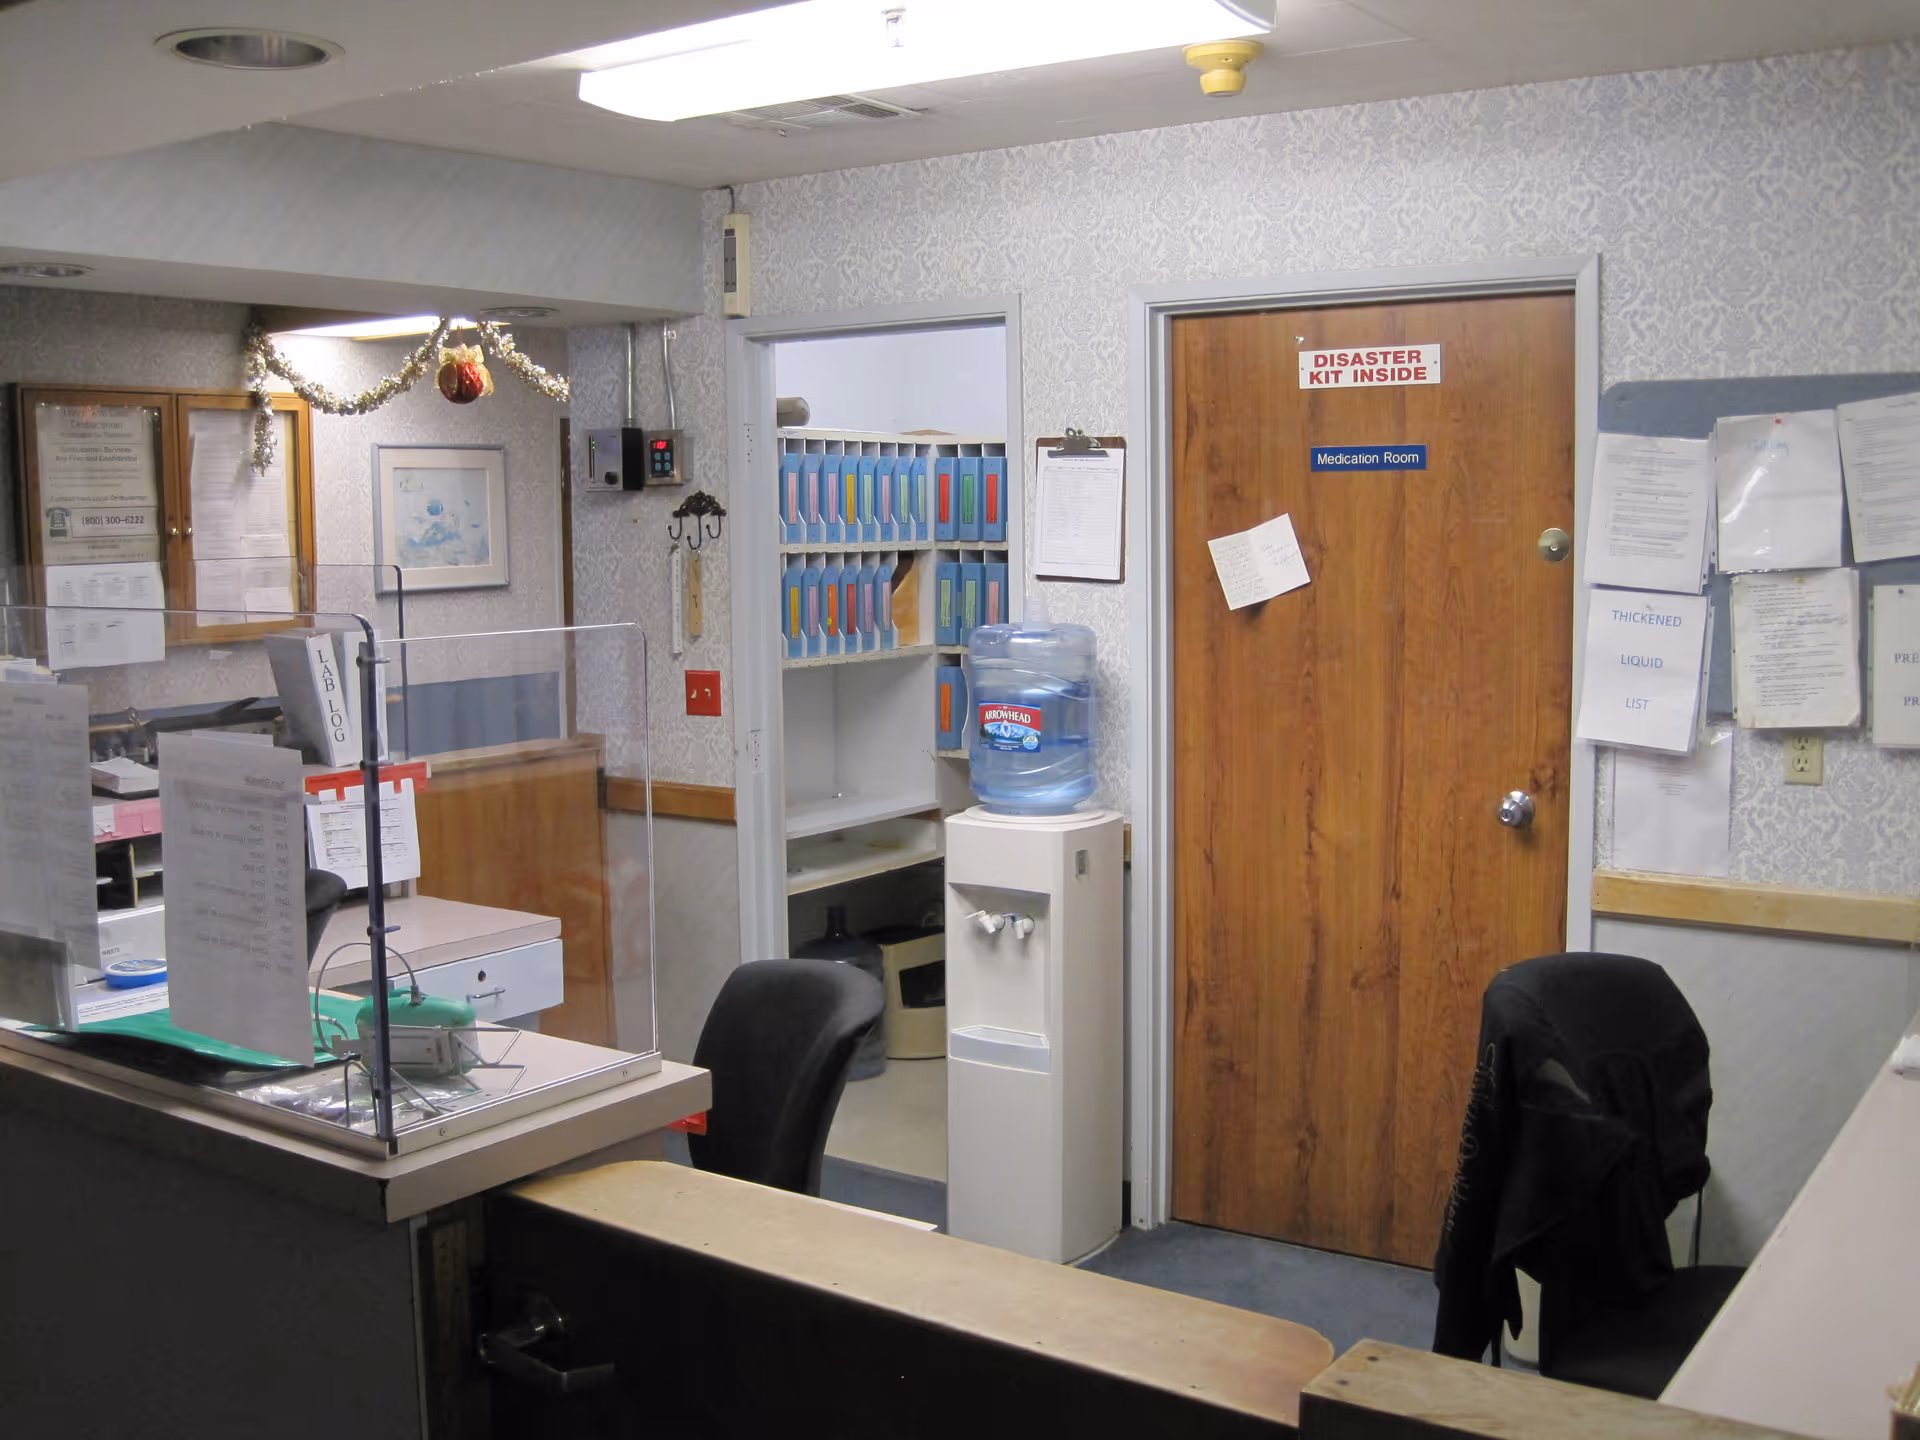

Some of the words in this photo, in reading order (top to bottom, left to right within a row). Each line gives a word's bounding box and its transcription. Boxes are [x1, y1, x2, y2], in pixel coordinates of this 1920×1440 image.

[1313, 350, 1422, 368] DISASTER
[1309, 370, 1343, 385] KIT
[1353, 367, 1427, 384] INSIDE
[1317, 452, 1379, 465] Medication
[1384, 451, 1419, 464] Room
[1612, 609, 1682, 628] THICKENED
[1620, 653, 1664, 669] LIQUID
[316, 649, 335, 692] LAB
[328, 699, 346, 743] LOG
[1625, 697, 1650, 711] LIST
[984, 710, 1031, 723] ARROWHEAD
